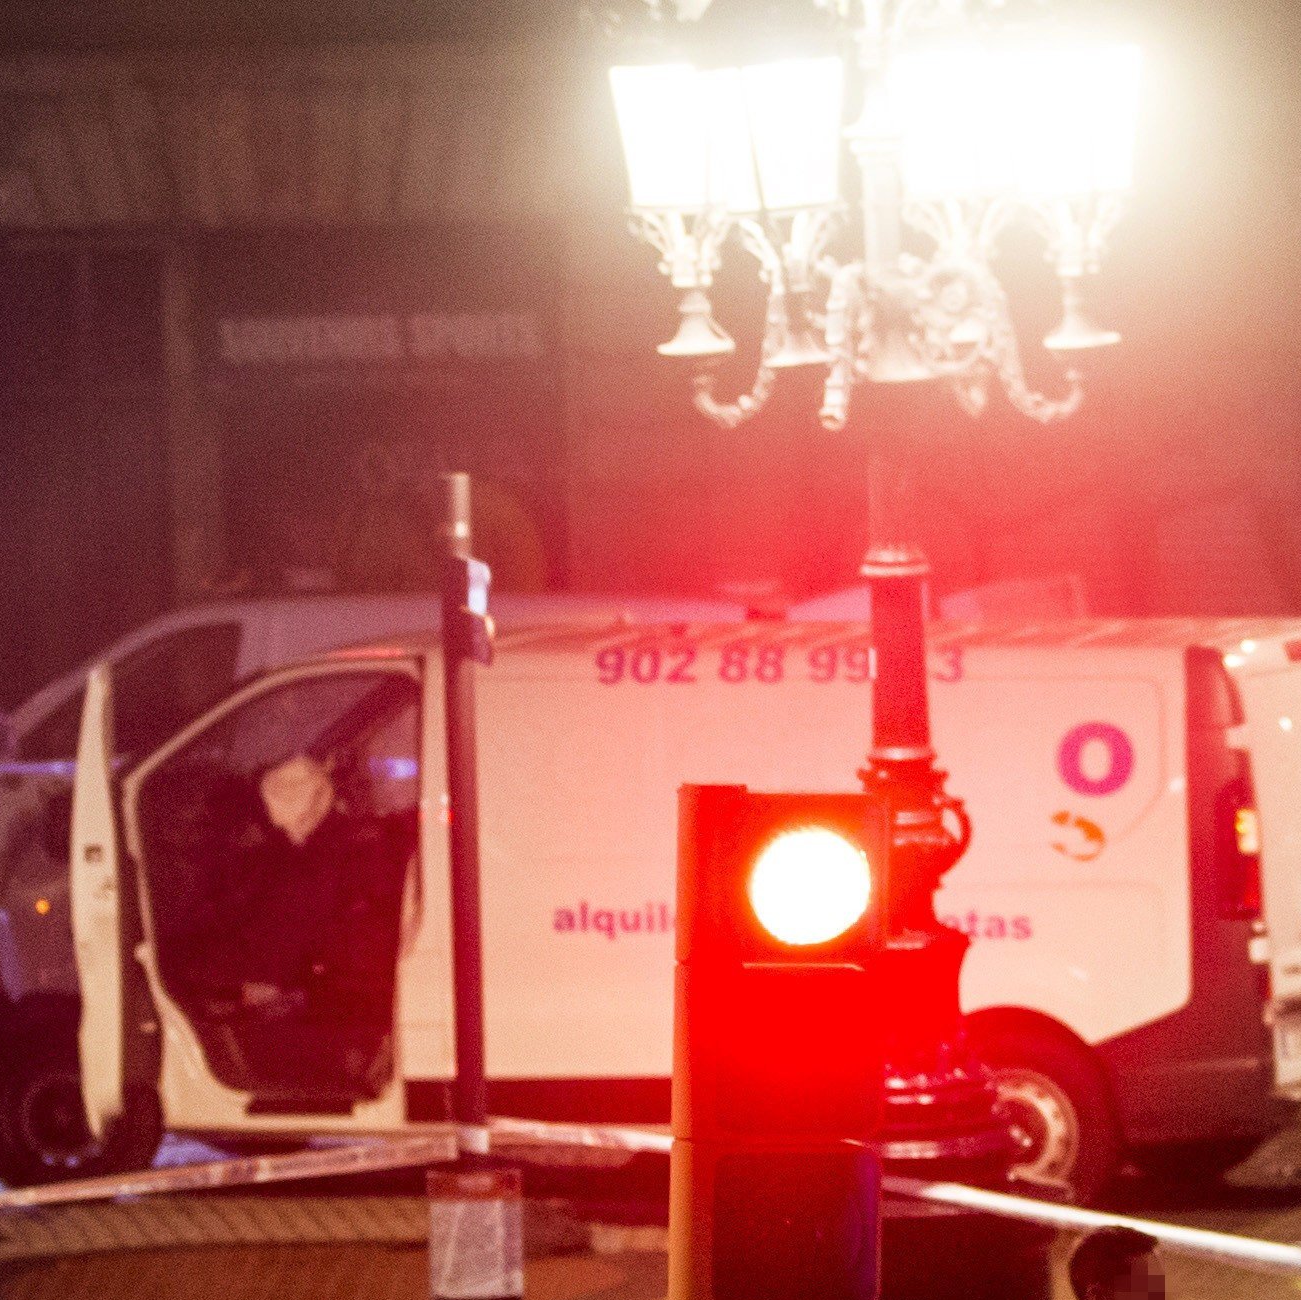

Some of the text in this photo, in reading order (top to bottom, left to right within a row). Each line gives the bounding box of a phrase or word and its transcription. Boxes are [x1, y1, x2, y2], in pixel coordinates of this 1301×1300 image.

[596, 645, 698, 686] 902
[718, 644, 786, 686] 88
[807, 645, 872, 686] 99
[553, 899, 675, 941] alquil
